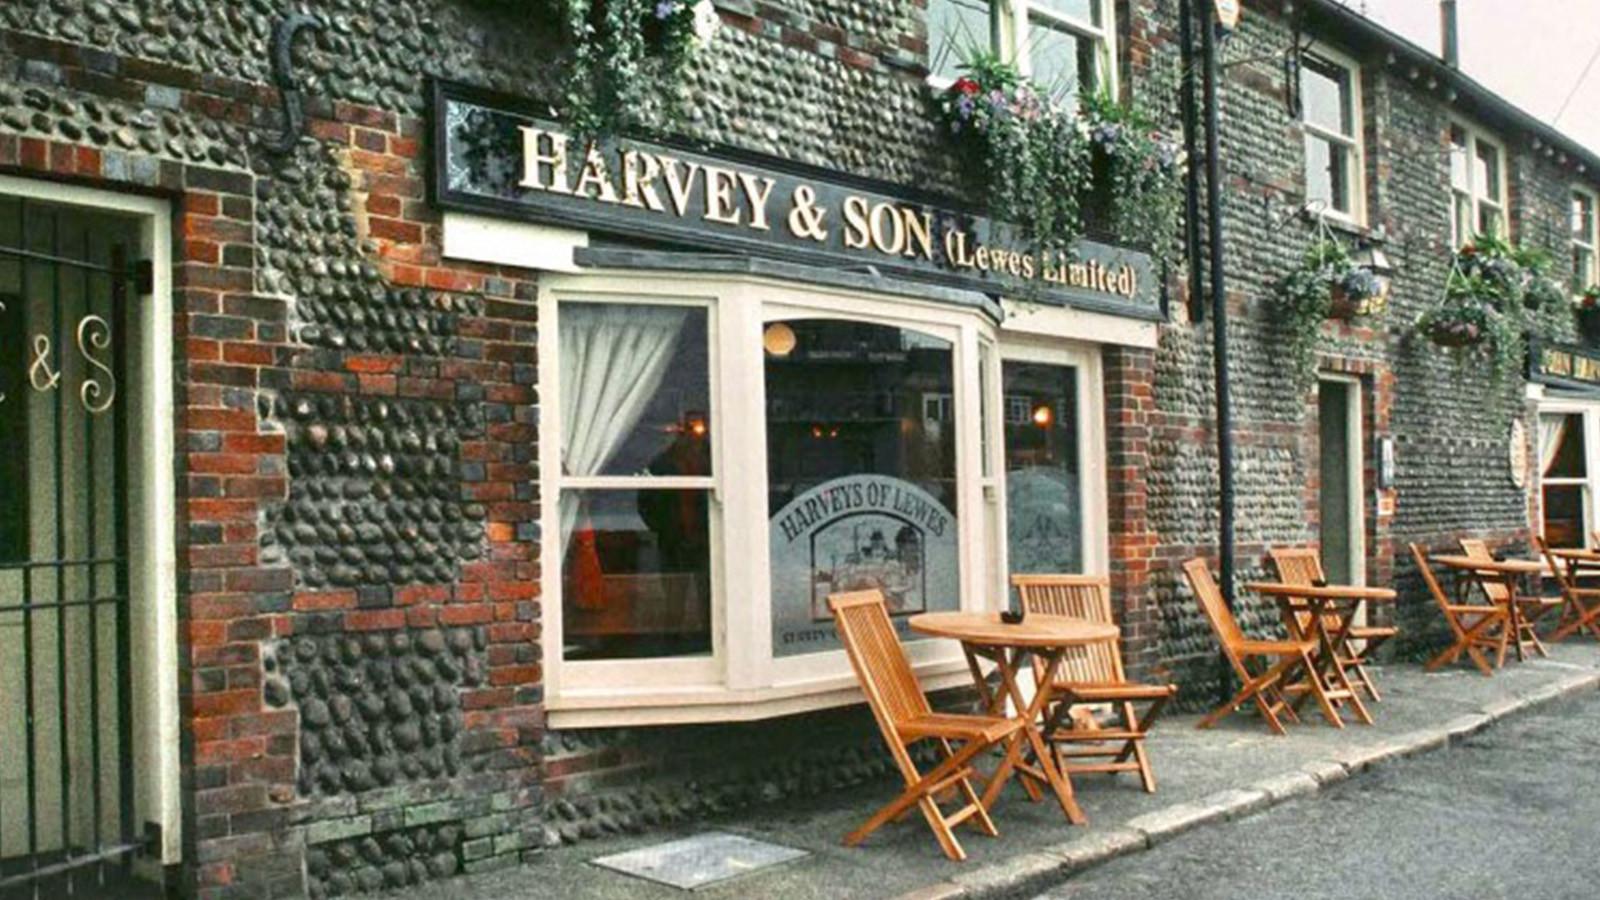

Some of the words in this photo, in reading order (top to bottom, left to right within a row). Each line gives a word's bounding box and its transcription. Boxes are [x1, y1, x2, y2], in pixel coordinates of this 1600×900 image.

[517, 125, 777, 231] HARVEY
[788, 185, 828, 242] &
[843, 195, 933, 261] SON
[945, 228, 1034, 279] (Lewes
[1042, 250, 1136, 300] Limited)
[779, 482, 864, 543] HARVEYS
[867, 481, 891, 508] OF
[894, 487, 949, 538] LEWES
